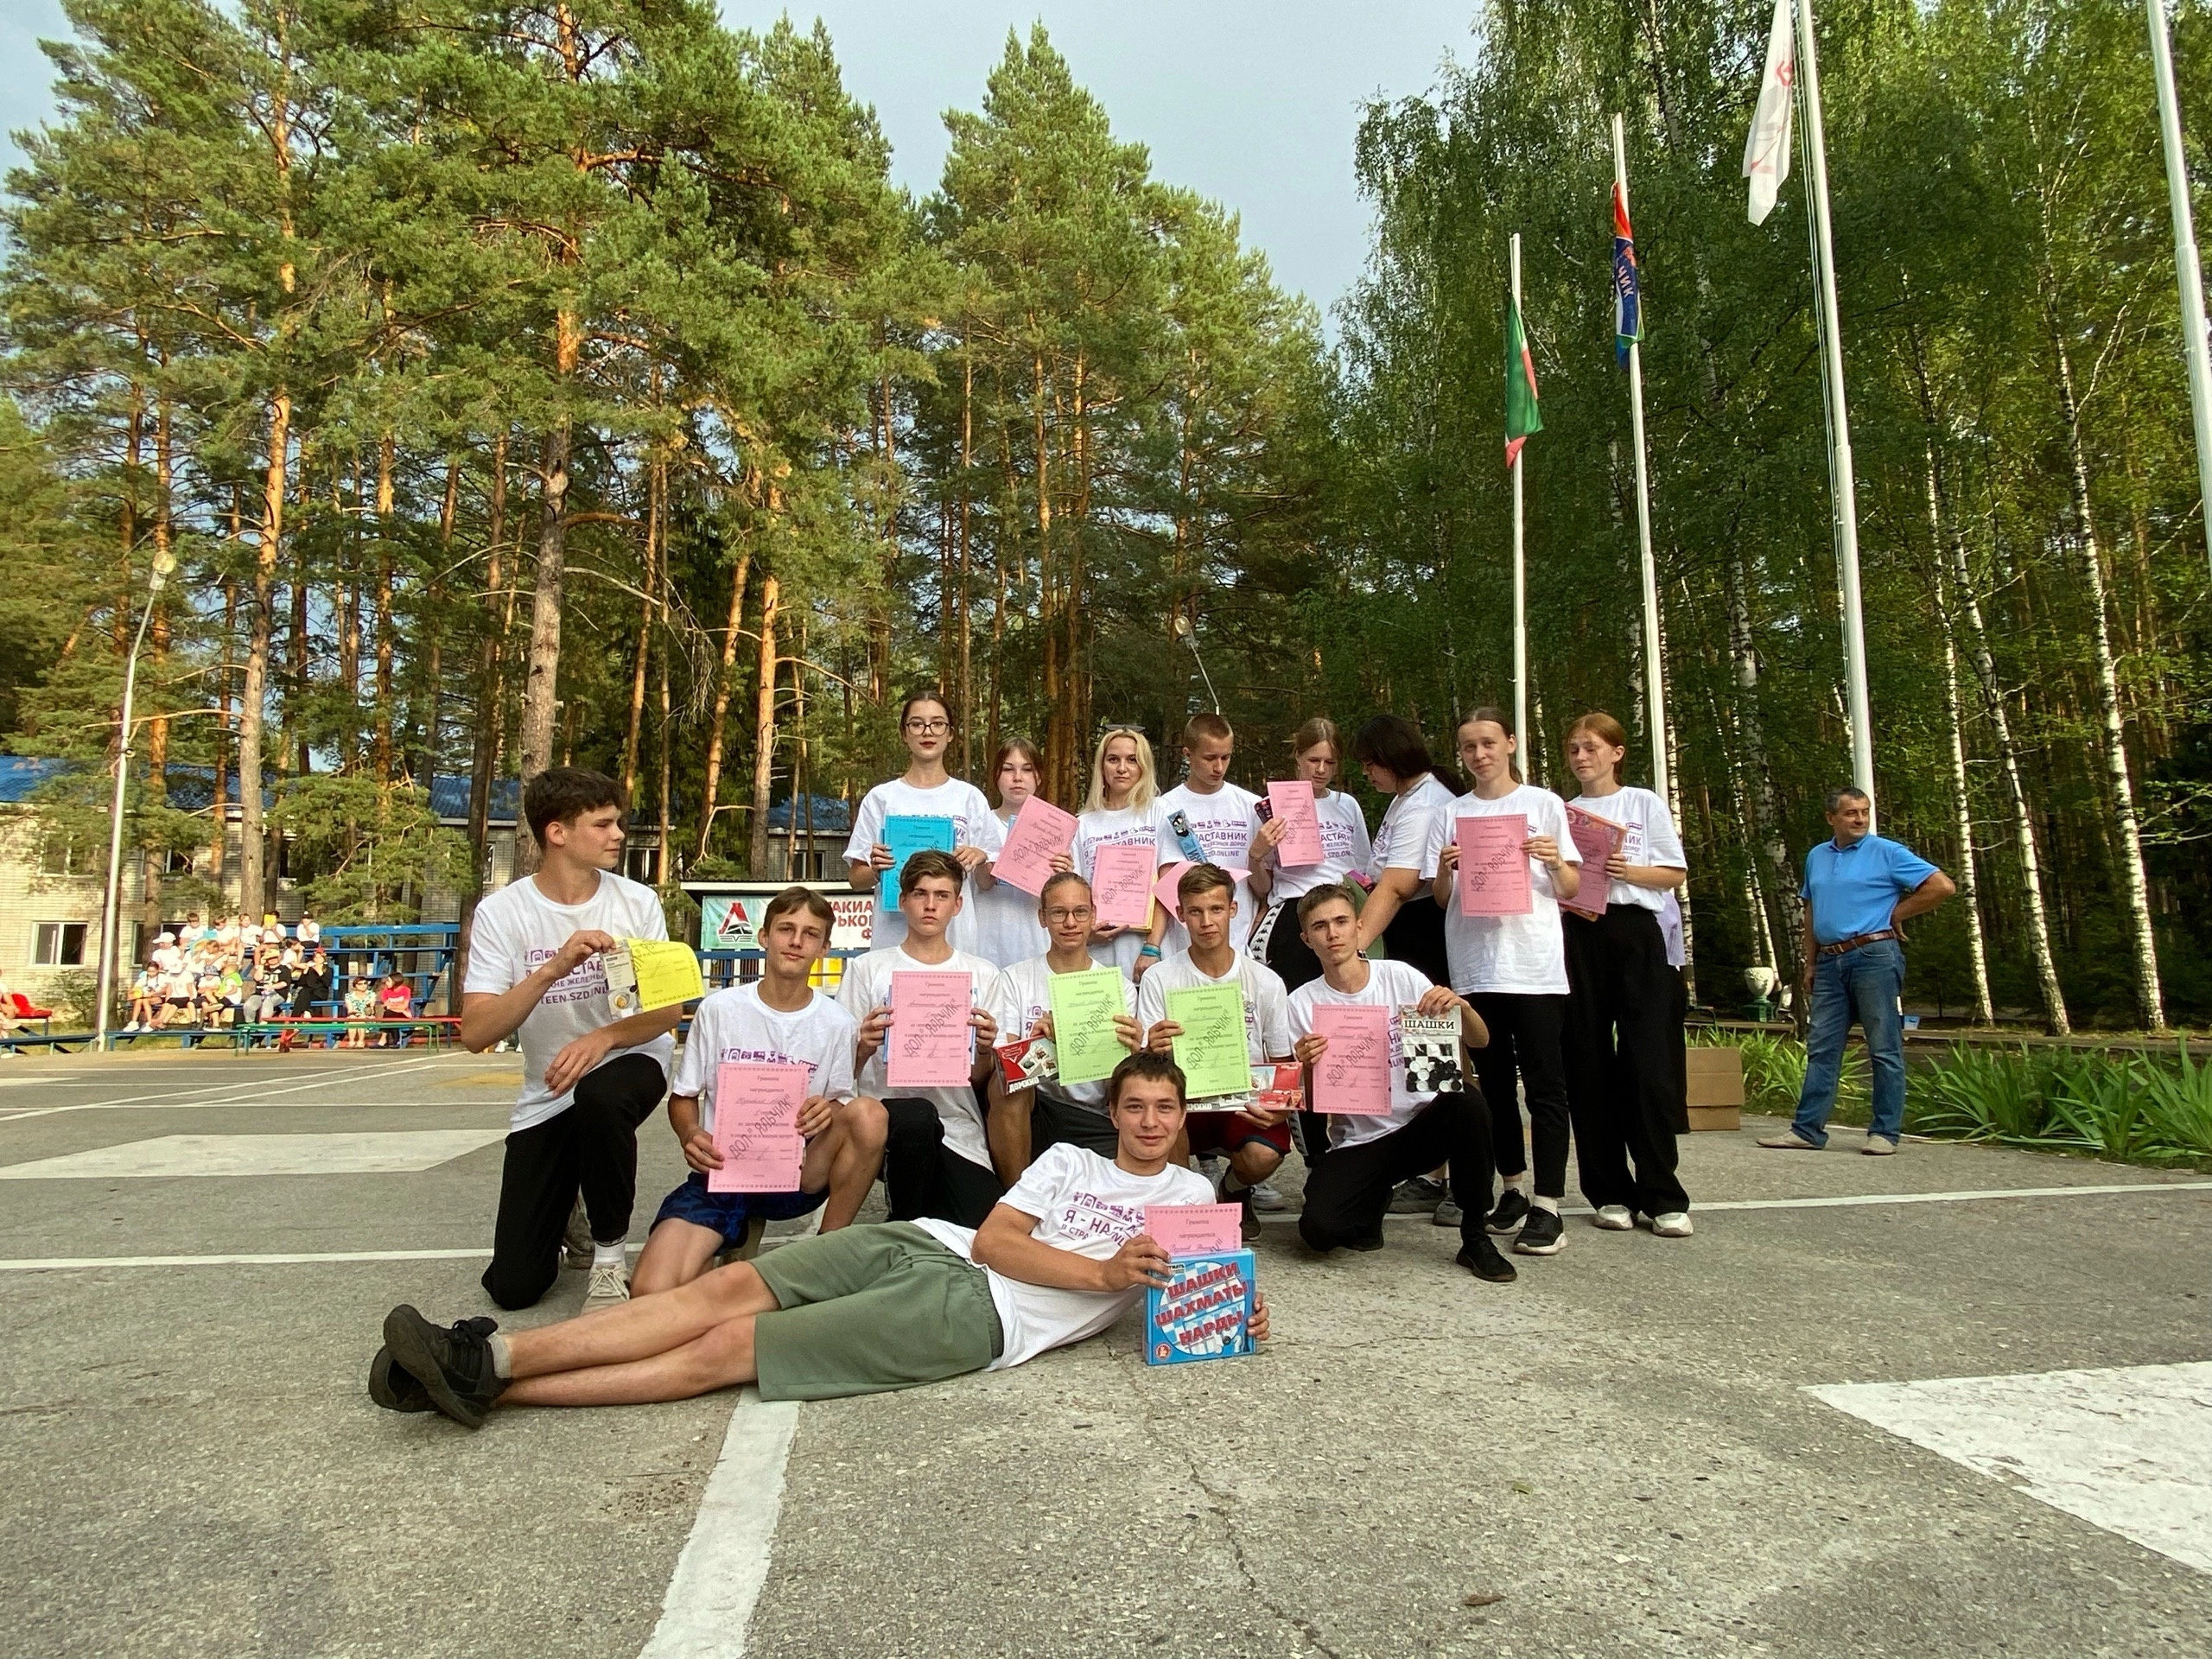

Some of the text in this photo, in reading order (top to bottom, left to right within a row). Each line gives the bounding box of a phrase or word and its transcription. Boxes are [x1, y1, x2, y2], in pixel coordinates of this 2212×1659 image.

[1025, 1021, 1033, 1032] Я
[1404, 1020, 1455, 1030] ШАШКИ
[728, 1134, 753, 1161] ДОЛ
[1064, 1210, 1077, 1224] Я
[1167, 1262, 1240, 1300] ШАШКИ
[1154, 1281, 1249, 1328] ШАХМАТЫ
[1179, 1310, 1244, 1346] НАРДЫ
